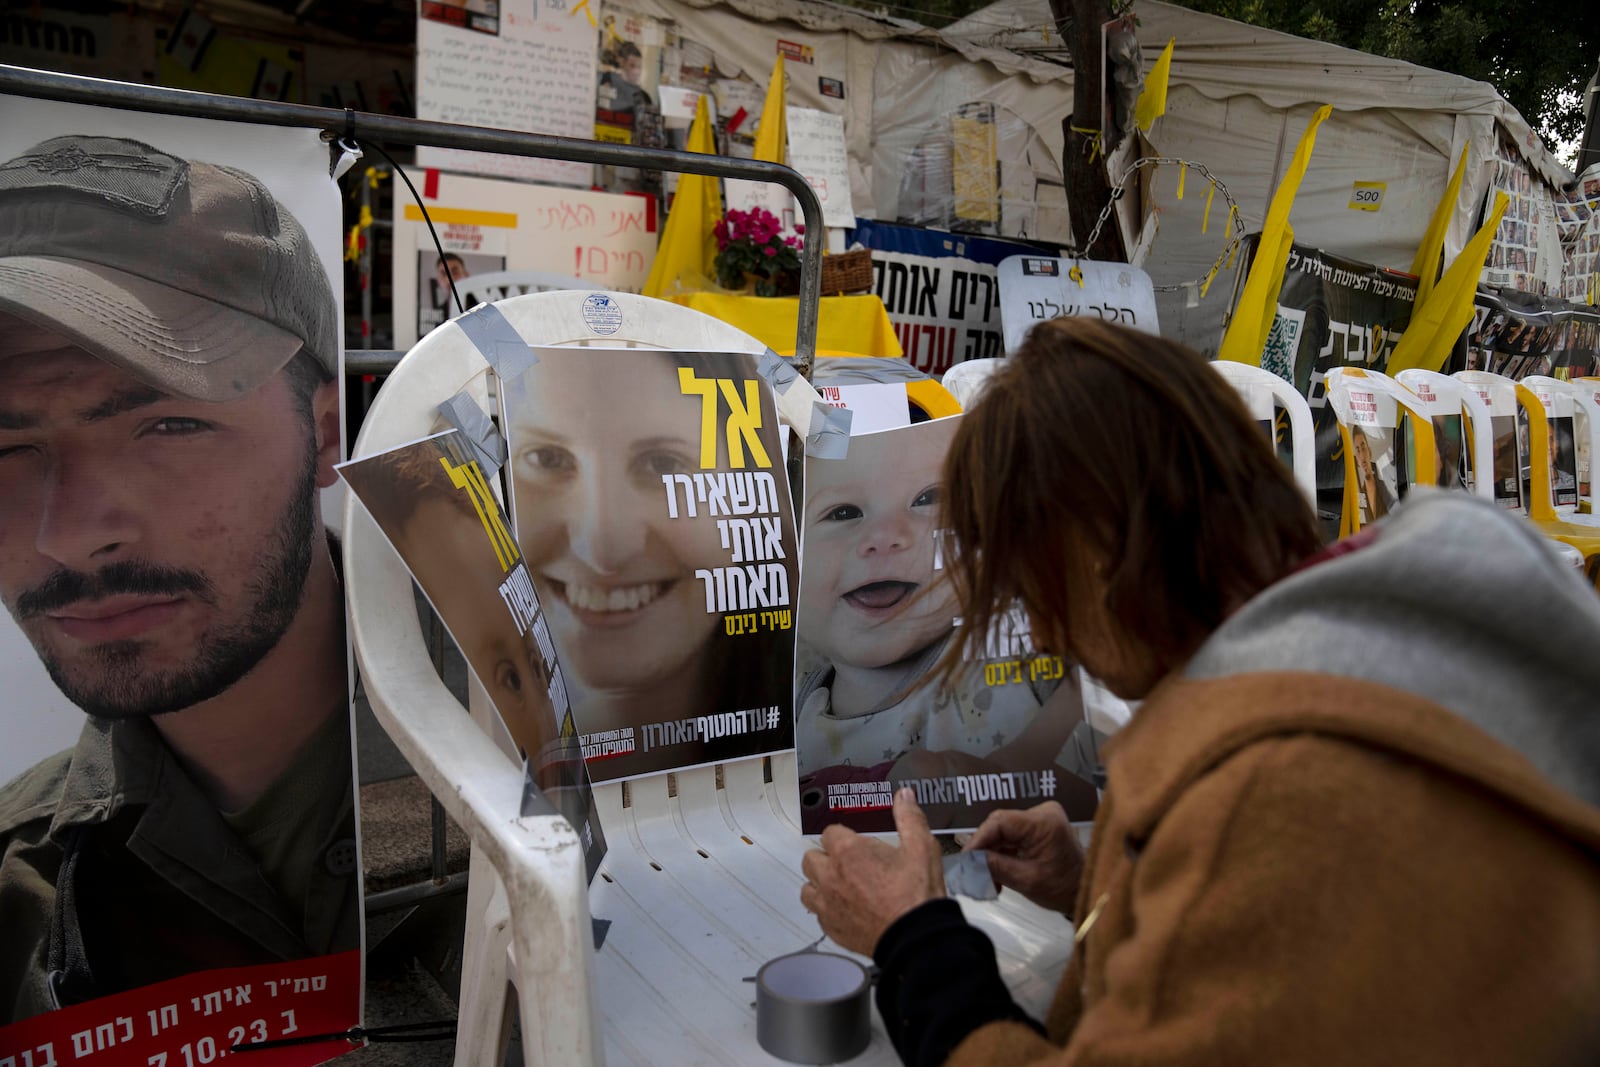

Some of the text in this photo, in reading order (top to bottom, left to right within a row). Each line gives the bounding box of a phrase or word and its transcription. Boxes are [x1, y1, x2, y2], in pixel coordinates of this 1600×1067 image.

[605, 210, 643, 237] אני
[574, 245, 644, 279] חיים!
[678, 367, 773, 469] אל
[662, 471, 779, 519] תשאירו
[439, 456, 520, 573] אל
[717, 516, 787, 563] אותי
[695, 563, 790, 614] מאחור
[724, 609, 792, 636] שירי ביבס
[985, 656, 1064, 686] כפיר ביבס
[602, 738, 635, 756] החטופים
[861, 792, 893, 808] החטופים
[191, 984, 252, 1016] איתי
[71, 1016, 135, 1059] לחם
[147, 1004, 179, 1037] חן
[148, 1009, 298, 1067] ב 710.23
